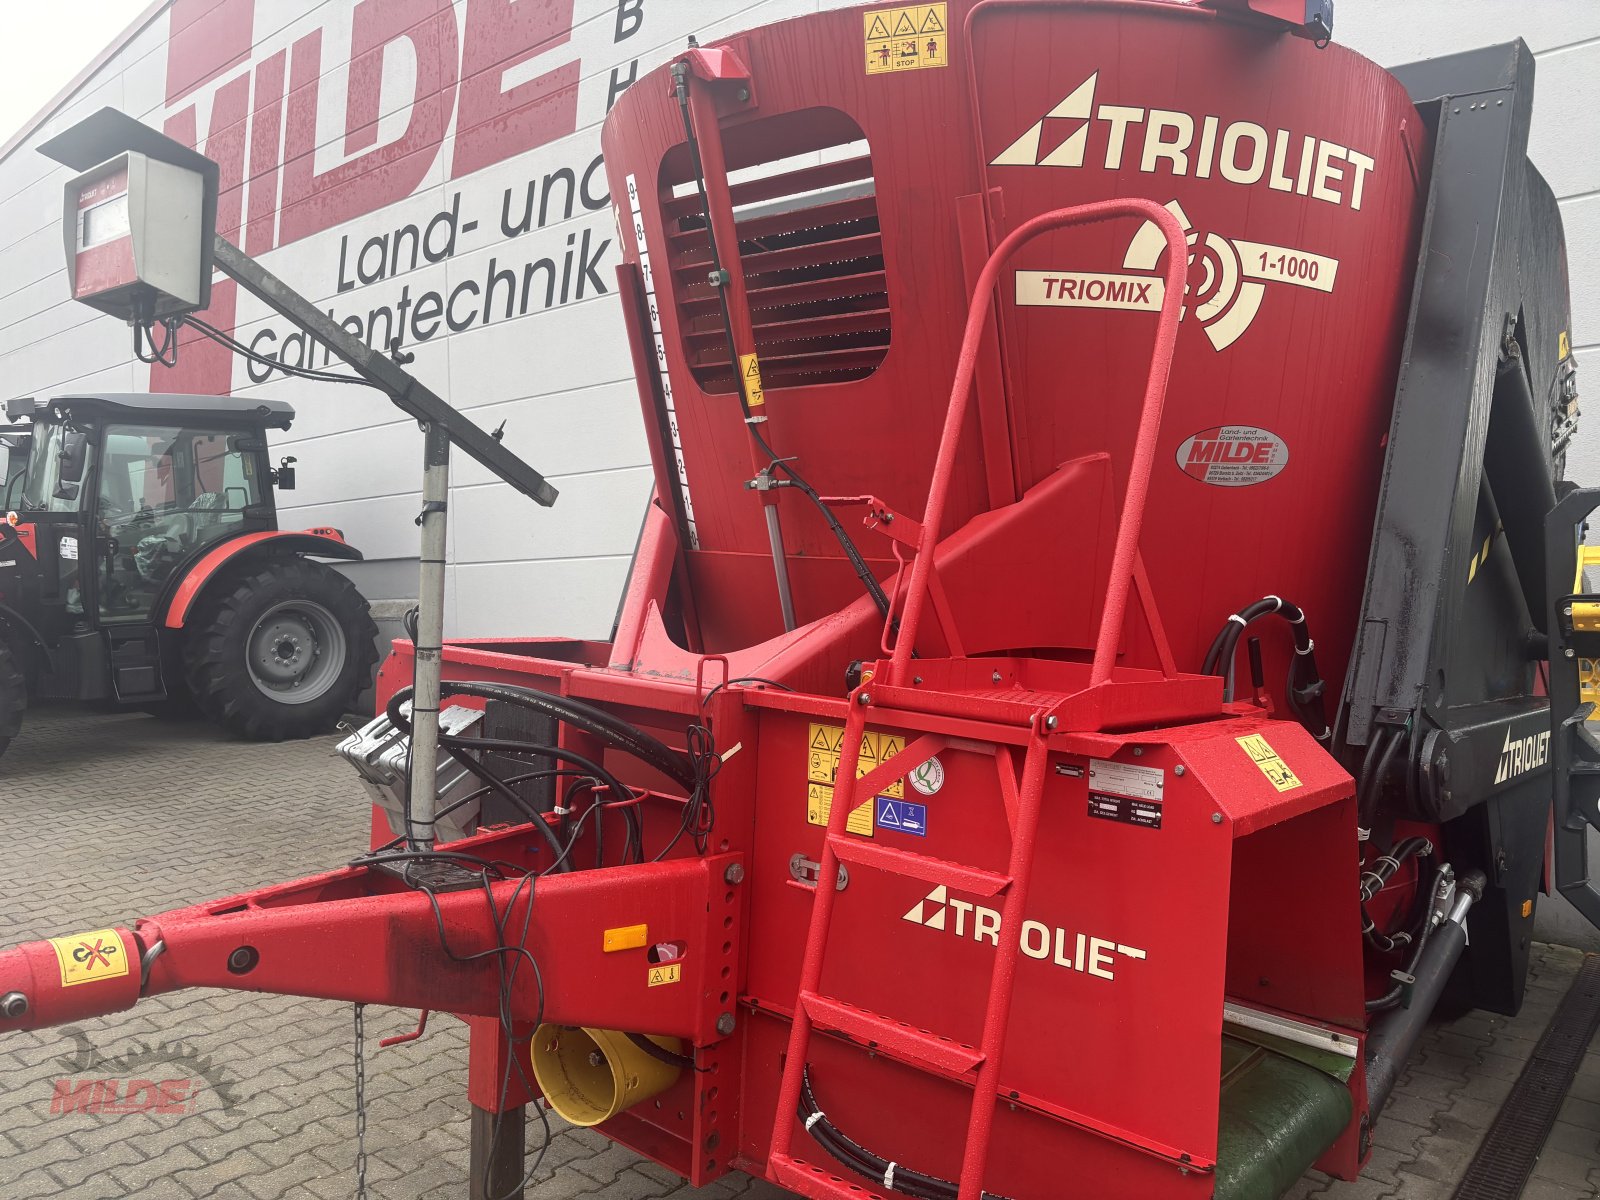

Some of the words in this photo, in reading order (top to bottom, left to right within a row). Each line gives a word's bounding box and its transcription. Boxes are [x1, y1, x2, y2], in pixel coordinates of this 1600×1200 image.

[1097, 104, 1375, 211] TRIOLIET
[336, 193, 479, 293] Land-
[1259, 251, 1319, 281] 1-1000
[1042, 277, 1152, 304] TRIOMIX
[1187, 441, 1274, 463] MILDE
[1509, 730, 1551, 779] TRIOLIET
[949, 897, 1147, 981] TROLIE
